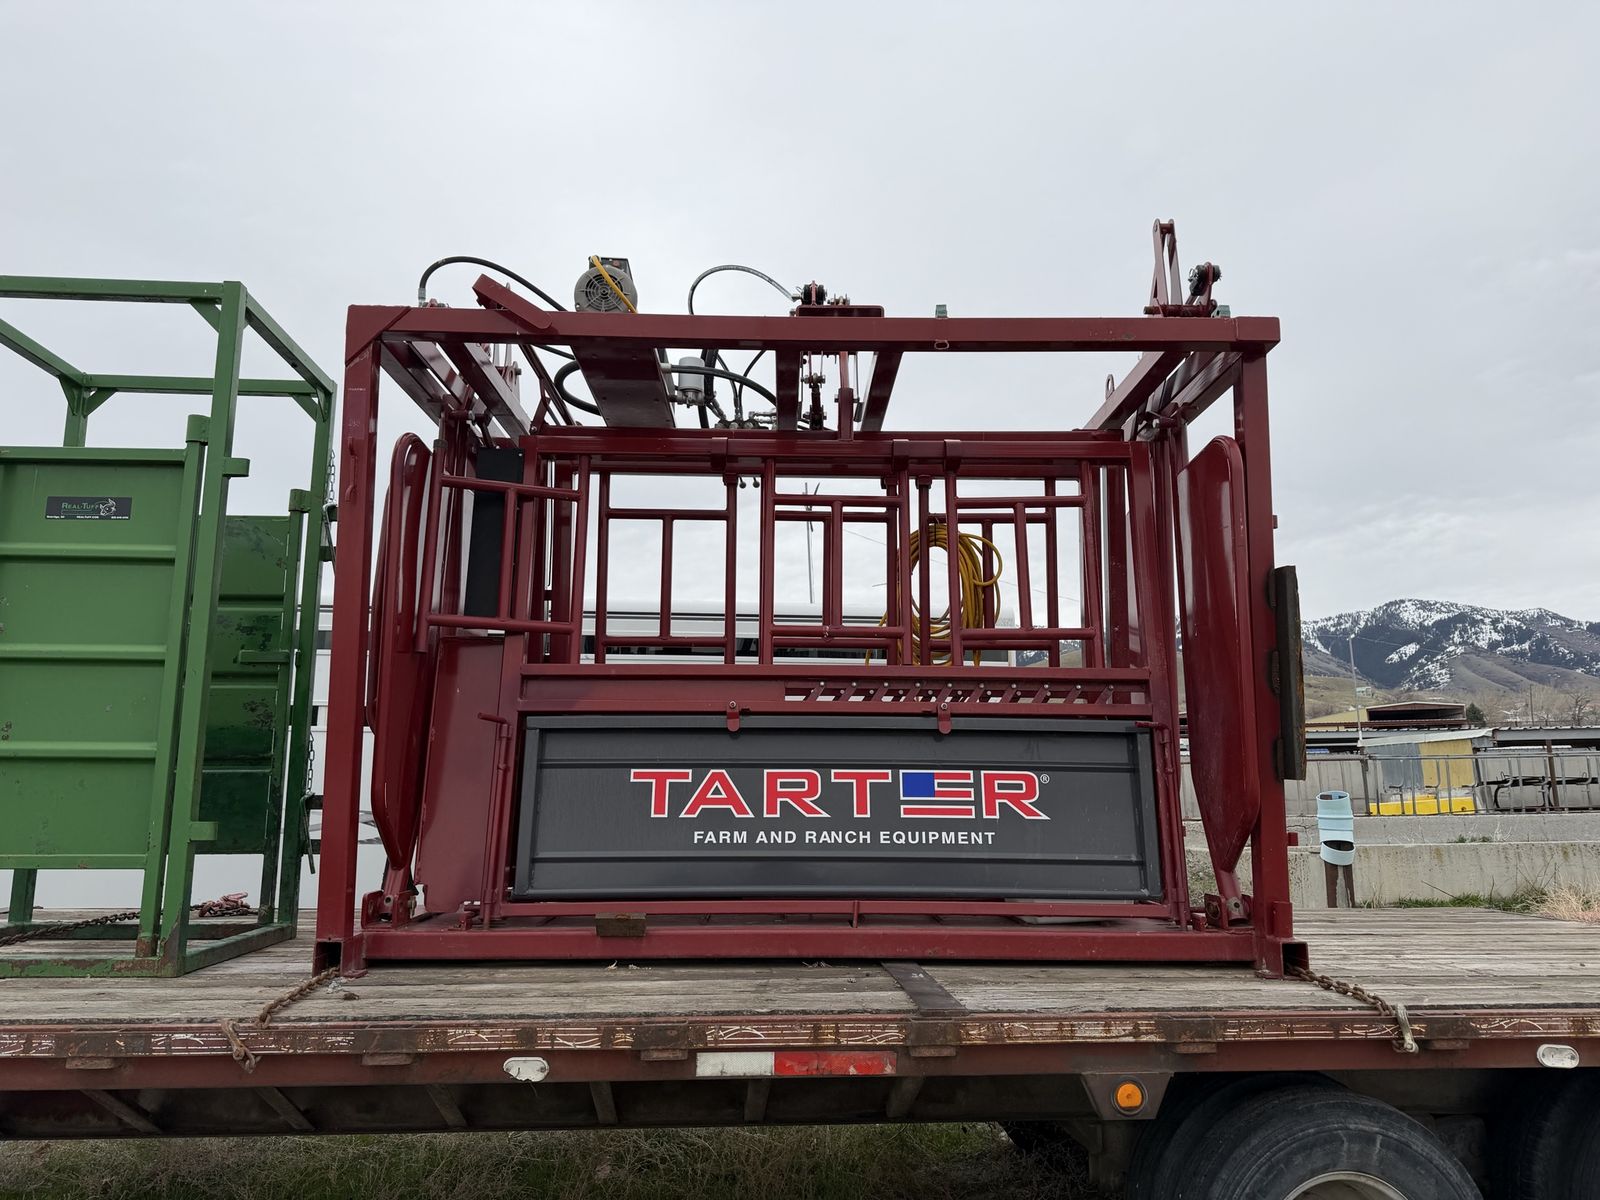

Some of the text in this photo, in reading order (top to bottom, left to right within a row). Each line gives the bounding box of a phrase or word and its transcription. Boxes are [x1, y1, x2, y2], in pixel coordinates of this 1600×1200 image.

[693, 830, 996, 845] FARM AND RANCH EQUIPMENT
